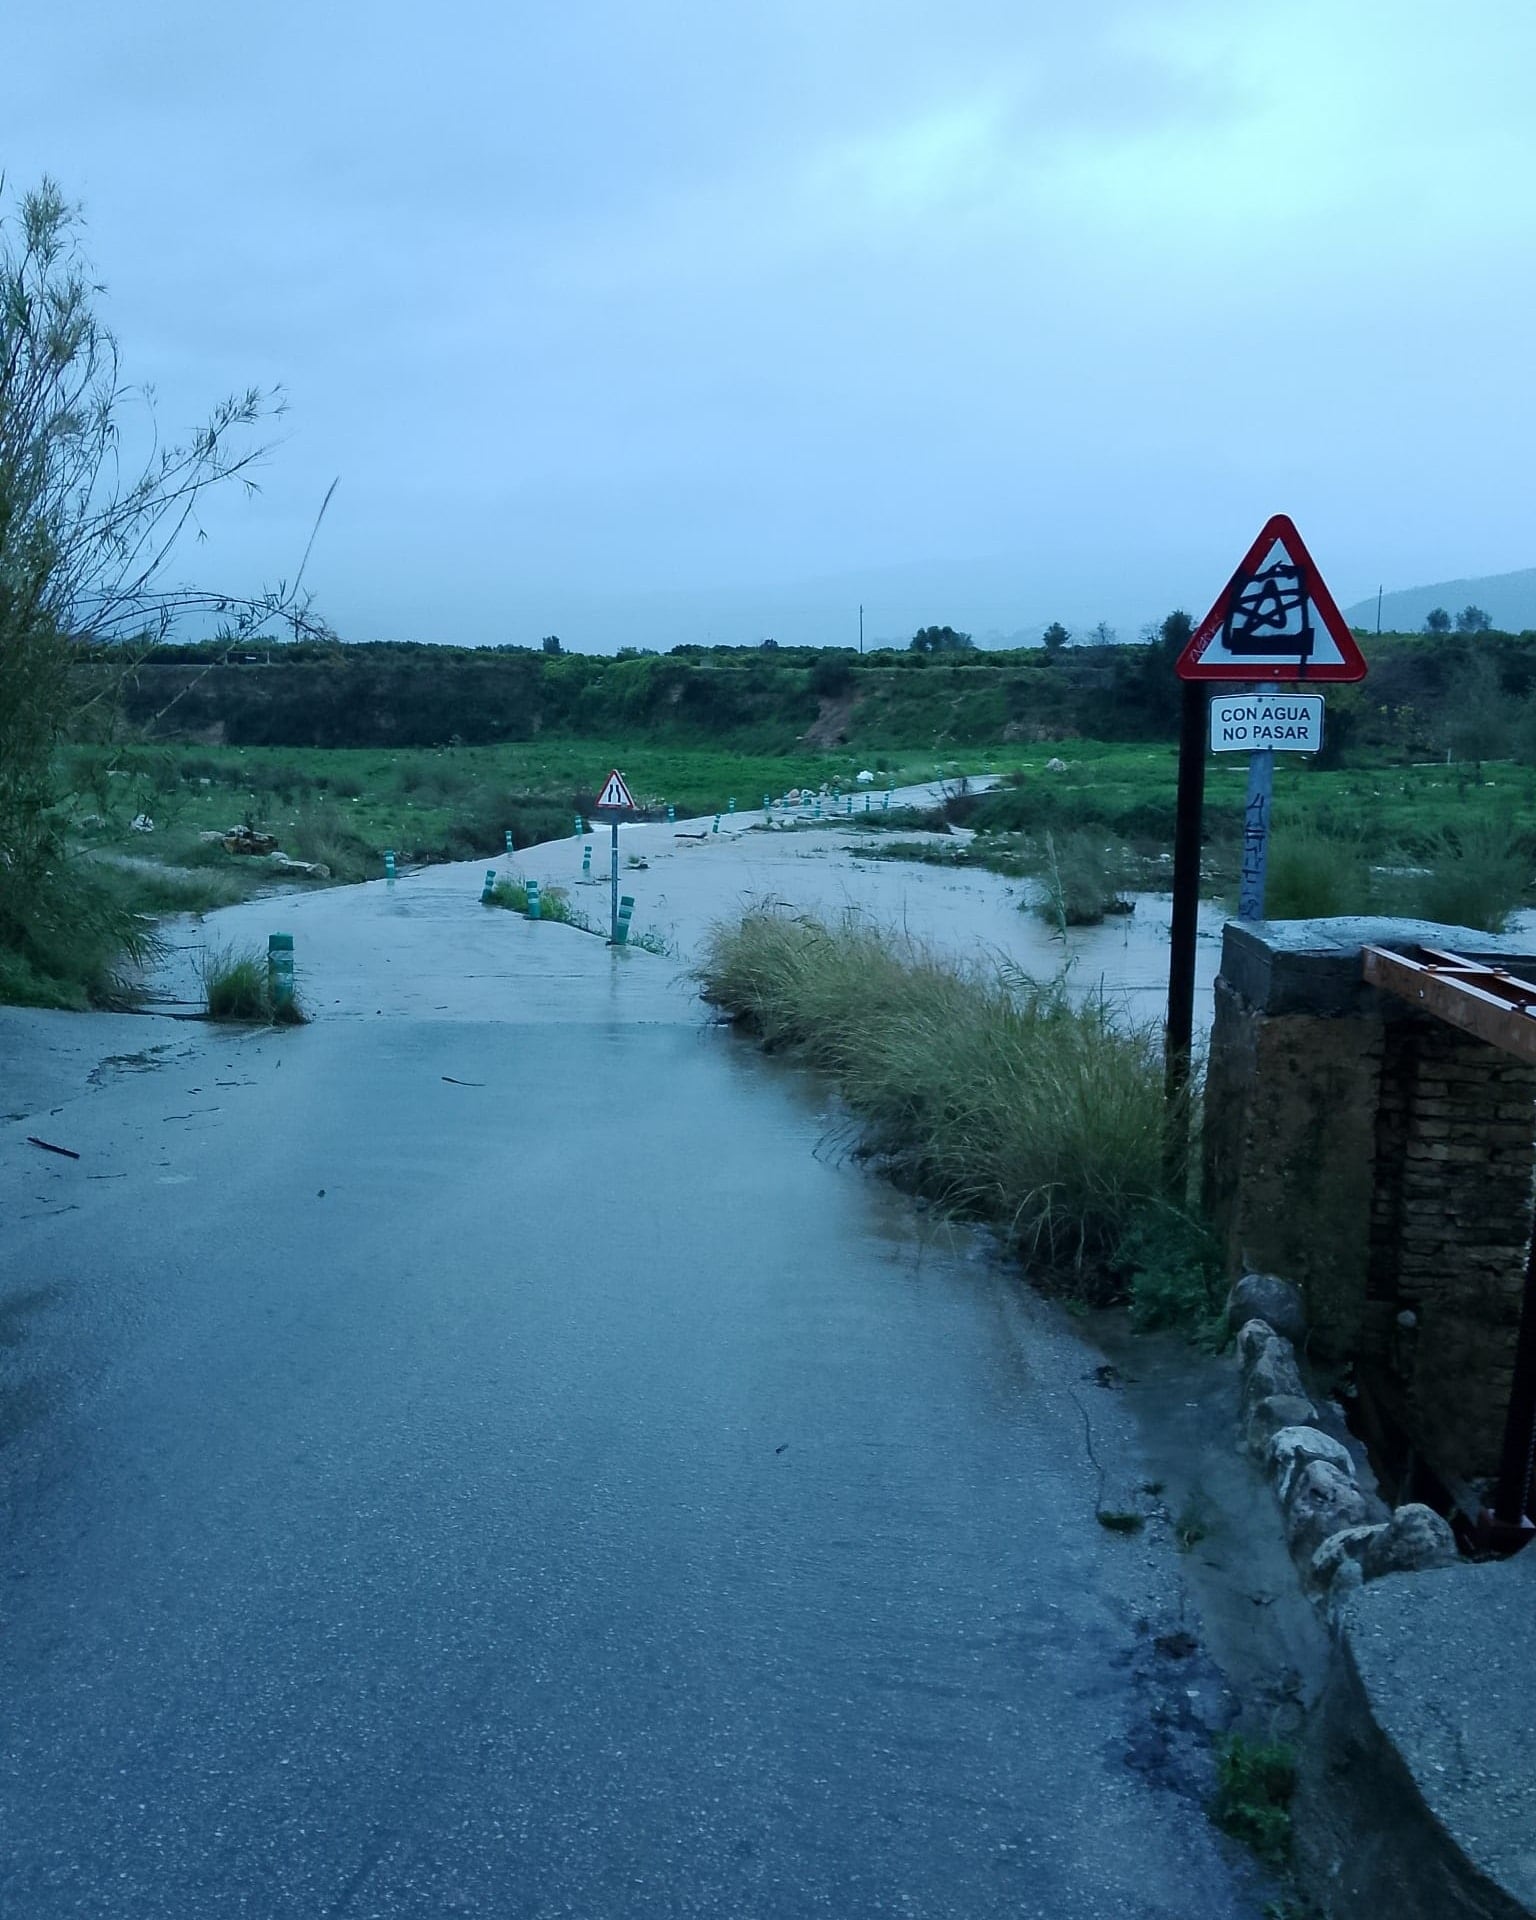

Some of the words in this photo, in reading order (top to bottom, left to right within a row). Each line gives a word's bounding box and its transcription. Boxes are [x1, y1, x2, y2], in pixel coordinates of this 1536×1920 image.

[1221, 707, 1257, 722] CON
[1261, 707, 1311, 721] AGUA
[1223, 726, 1247, 741] NO
[1253, 725, 1309, 740] PASAR
